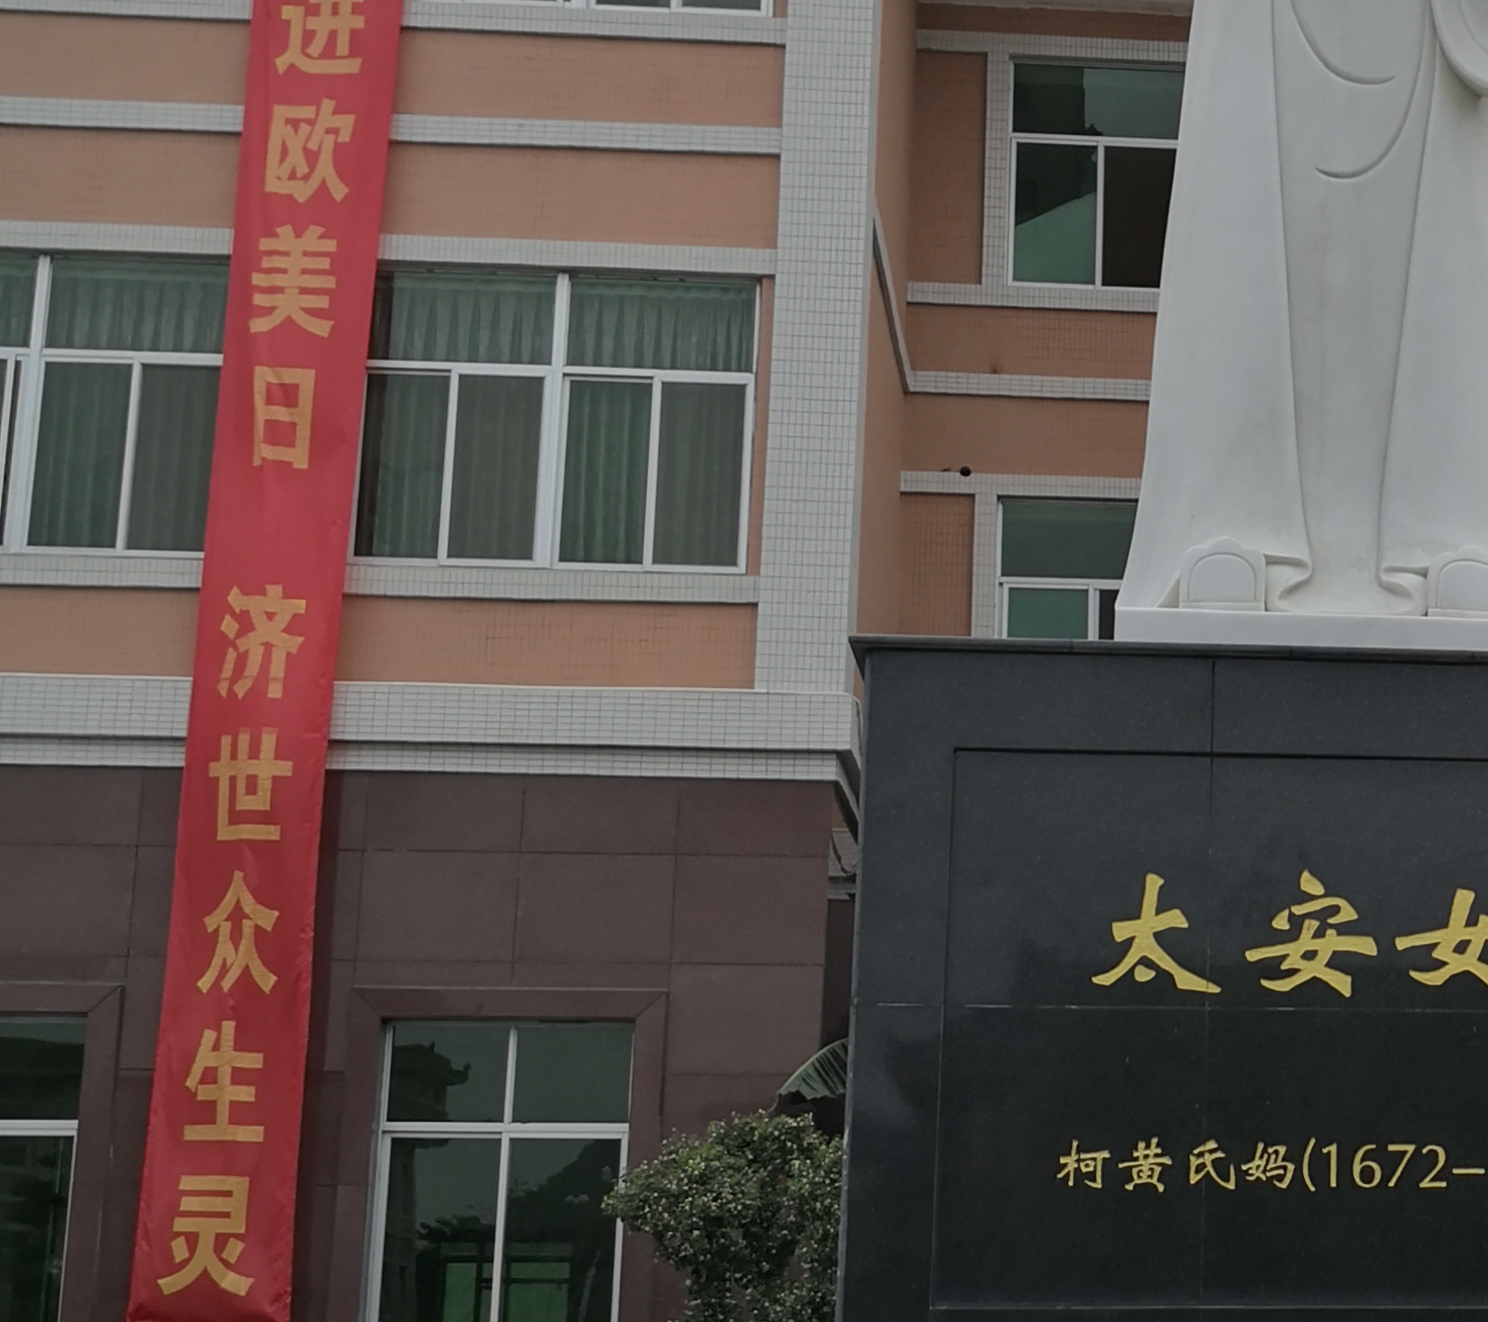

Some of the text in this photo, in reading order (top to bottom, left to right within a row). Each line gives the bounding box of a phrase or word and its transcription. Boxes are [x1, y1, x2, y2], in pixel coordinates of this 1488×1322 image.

[157, 584, 307, 1297] 济世众生灵
